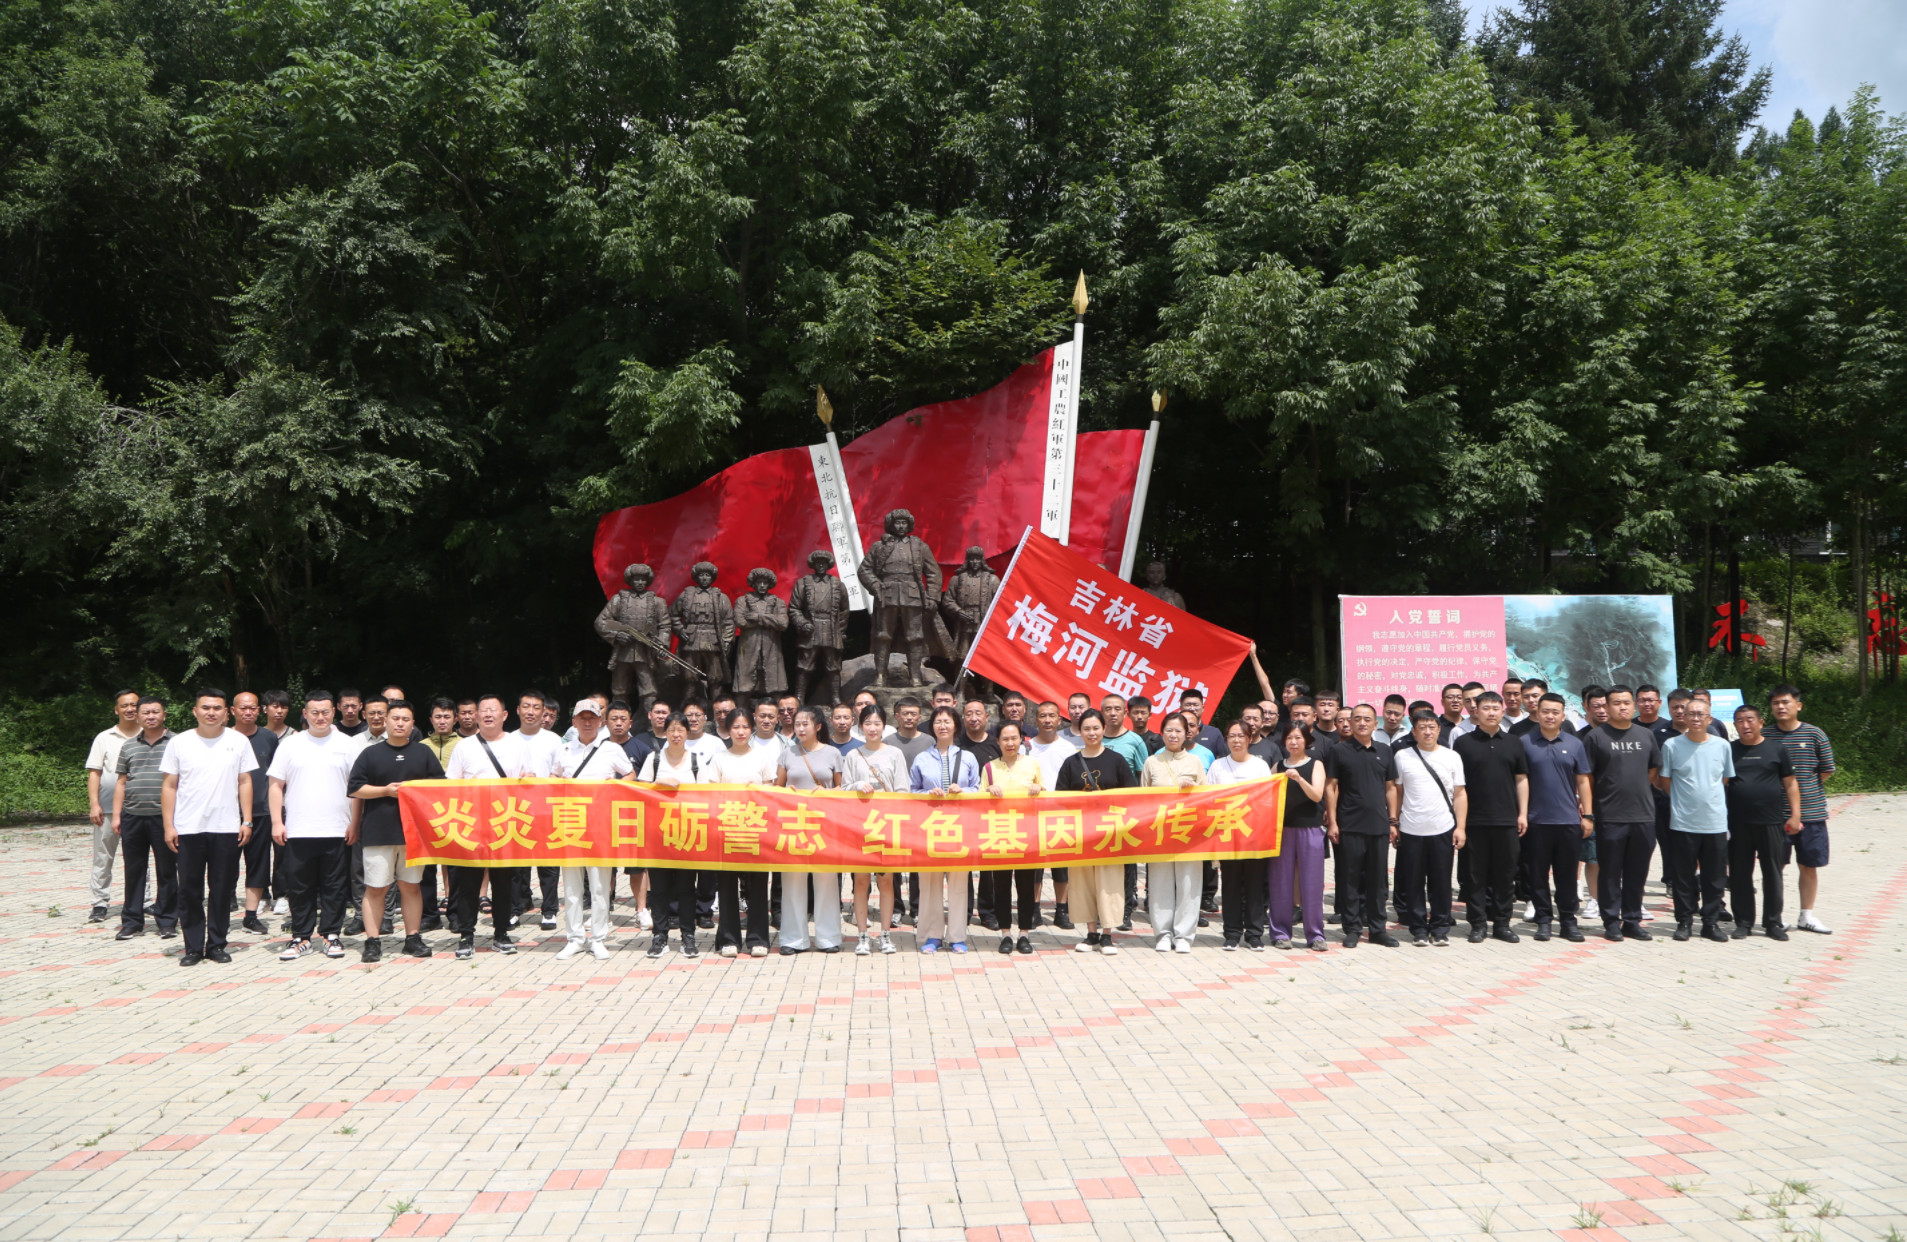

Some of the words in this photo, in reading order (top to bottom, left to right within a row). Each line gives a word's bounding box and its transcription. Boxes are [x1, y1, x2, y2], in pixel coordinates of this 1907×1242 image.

[1069, 578, 1174, 650] 吉林省
[1389, 609, 1461, 625] 入党誓词
[1611, 741, 1642, 750] NIKE
[429, 796, 827, 856] 炎炎夏日砺警志
[862, 794, 1254, 860] 红色基因永传承
